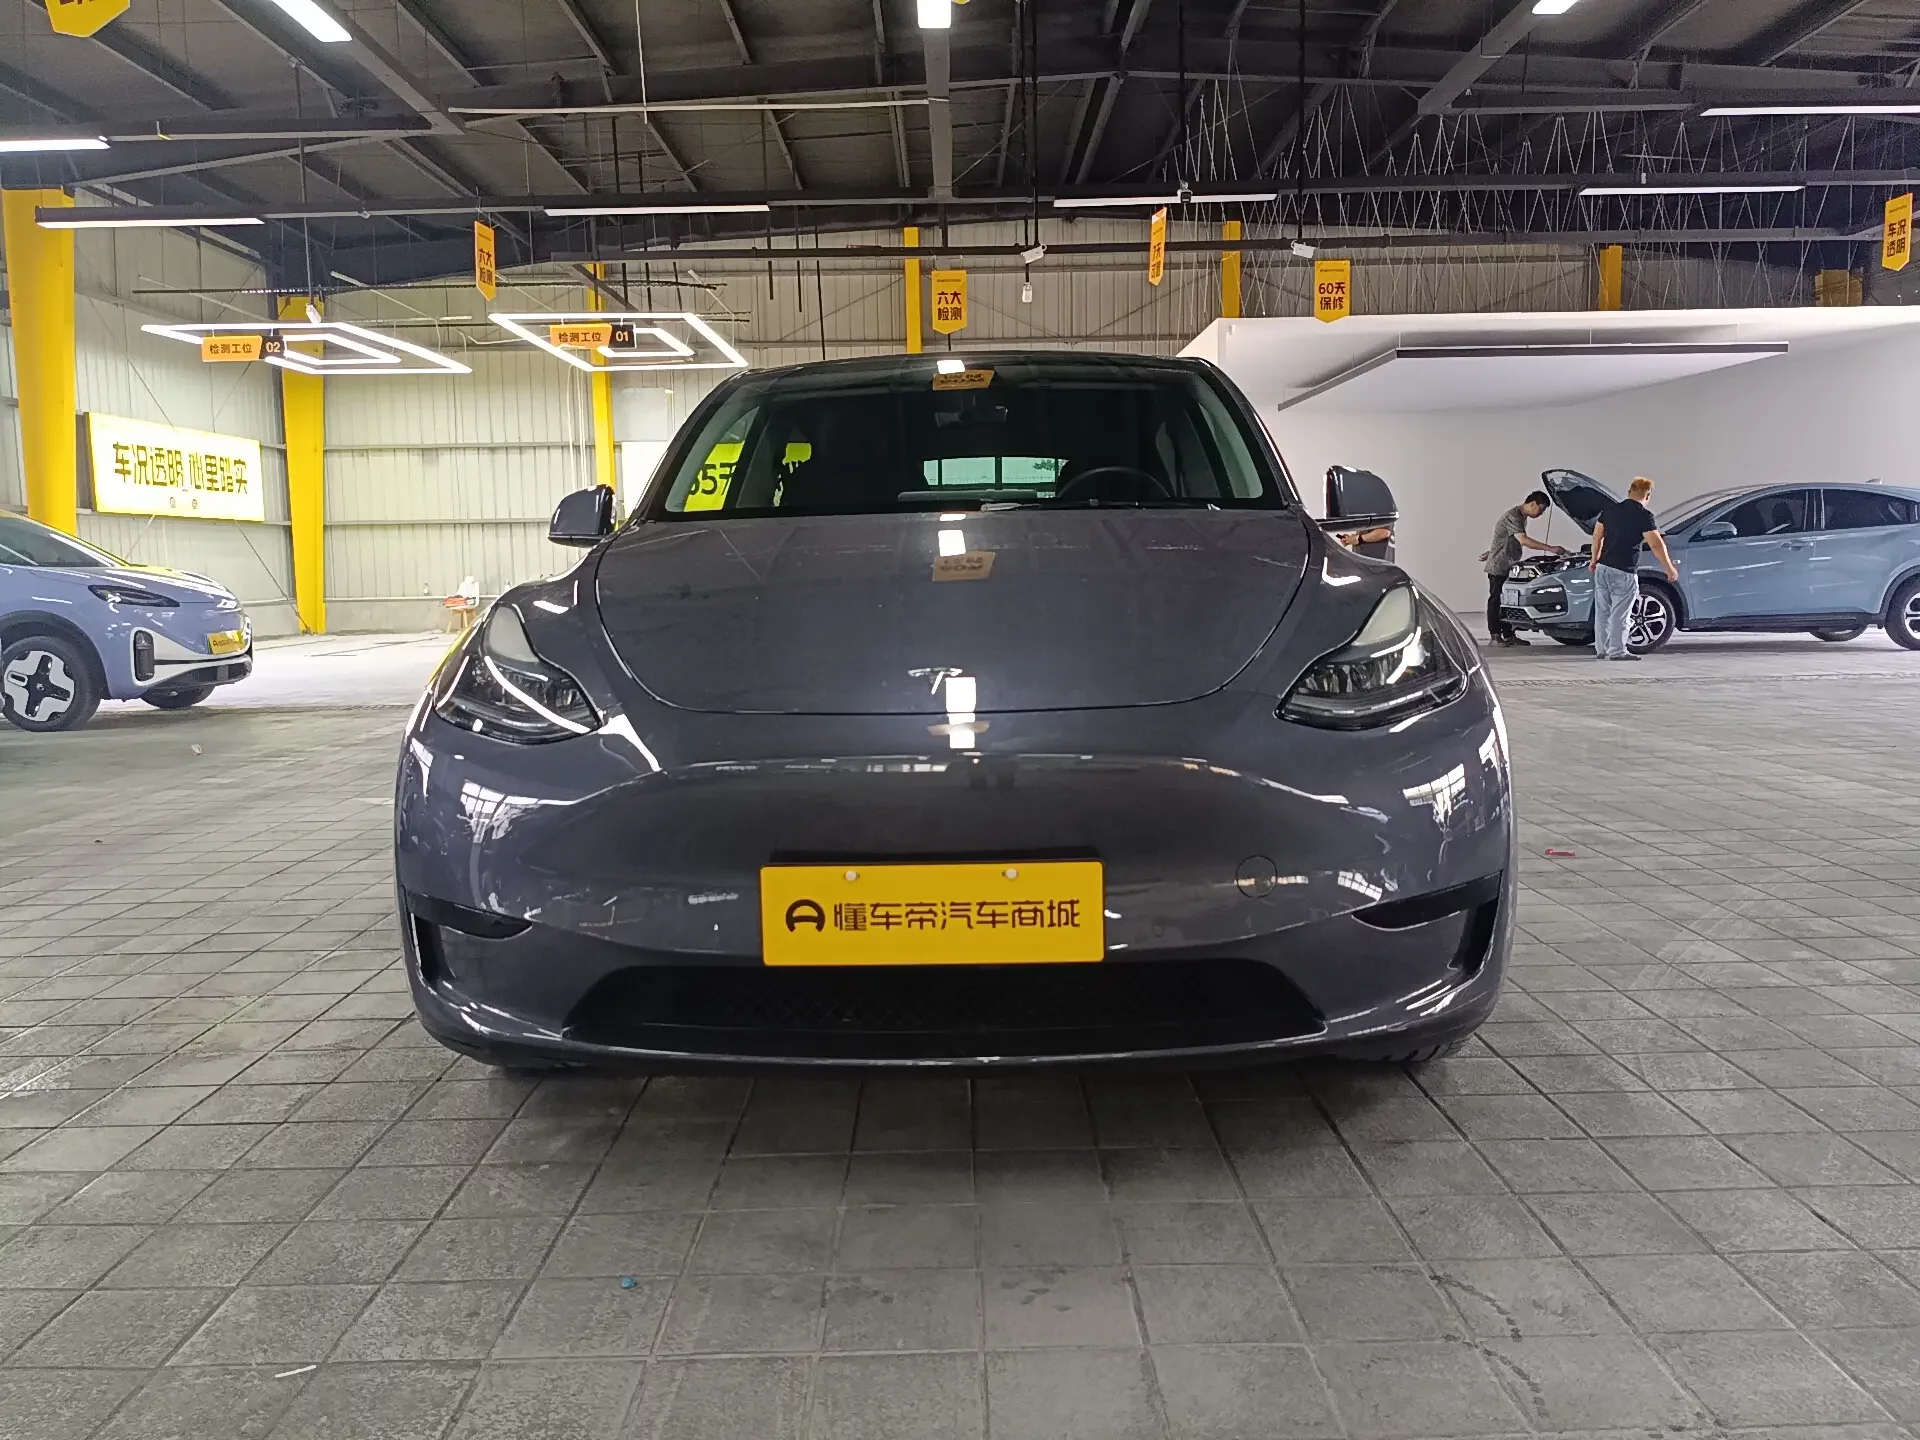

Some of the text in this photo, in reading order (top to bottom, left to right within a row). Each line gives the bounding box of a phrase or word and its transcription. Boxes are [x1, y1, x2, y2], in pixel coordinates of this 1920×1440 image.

[1887, 218, 1907, 238] 车况
[1886, 236, 1906, 258] 透明
[1318, 281, 1346, 295] 60天
[937, 290, 962, 305] 六大
[1319, 296, 1344, 311] 保修
[937, 306, 962, 321] 检测
[558, 330, 629, 343] 检测工位 01
[209, 341, 281, 355] 检测工位 02
[112, 441, 184, 488] 车况透明
[833, 898, 1081, 931] 懂车帝汽车商城
